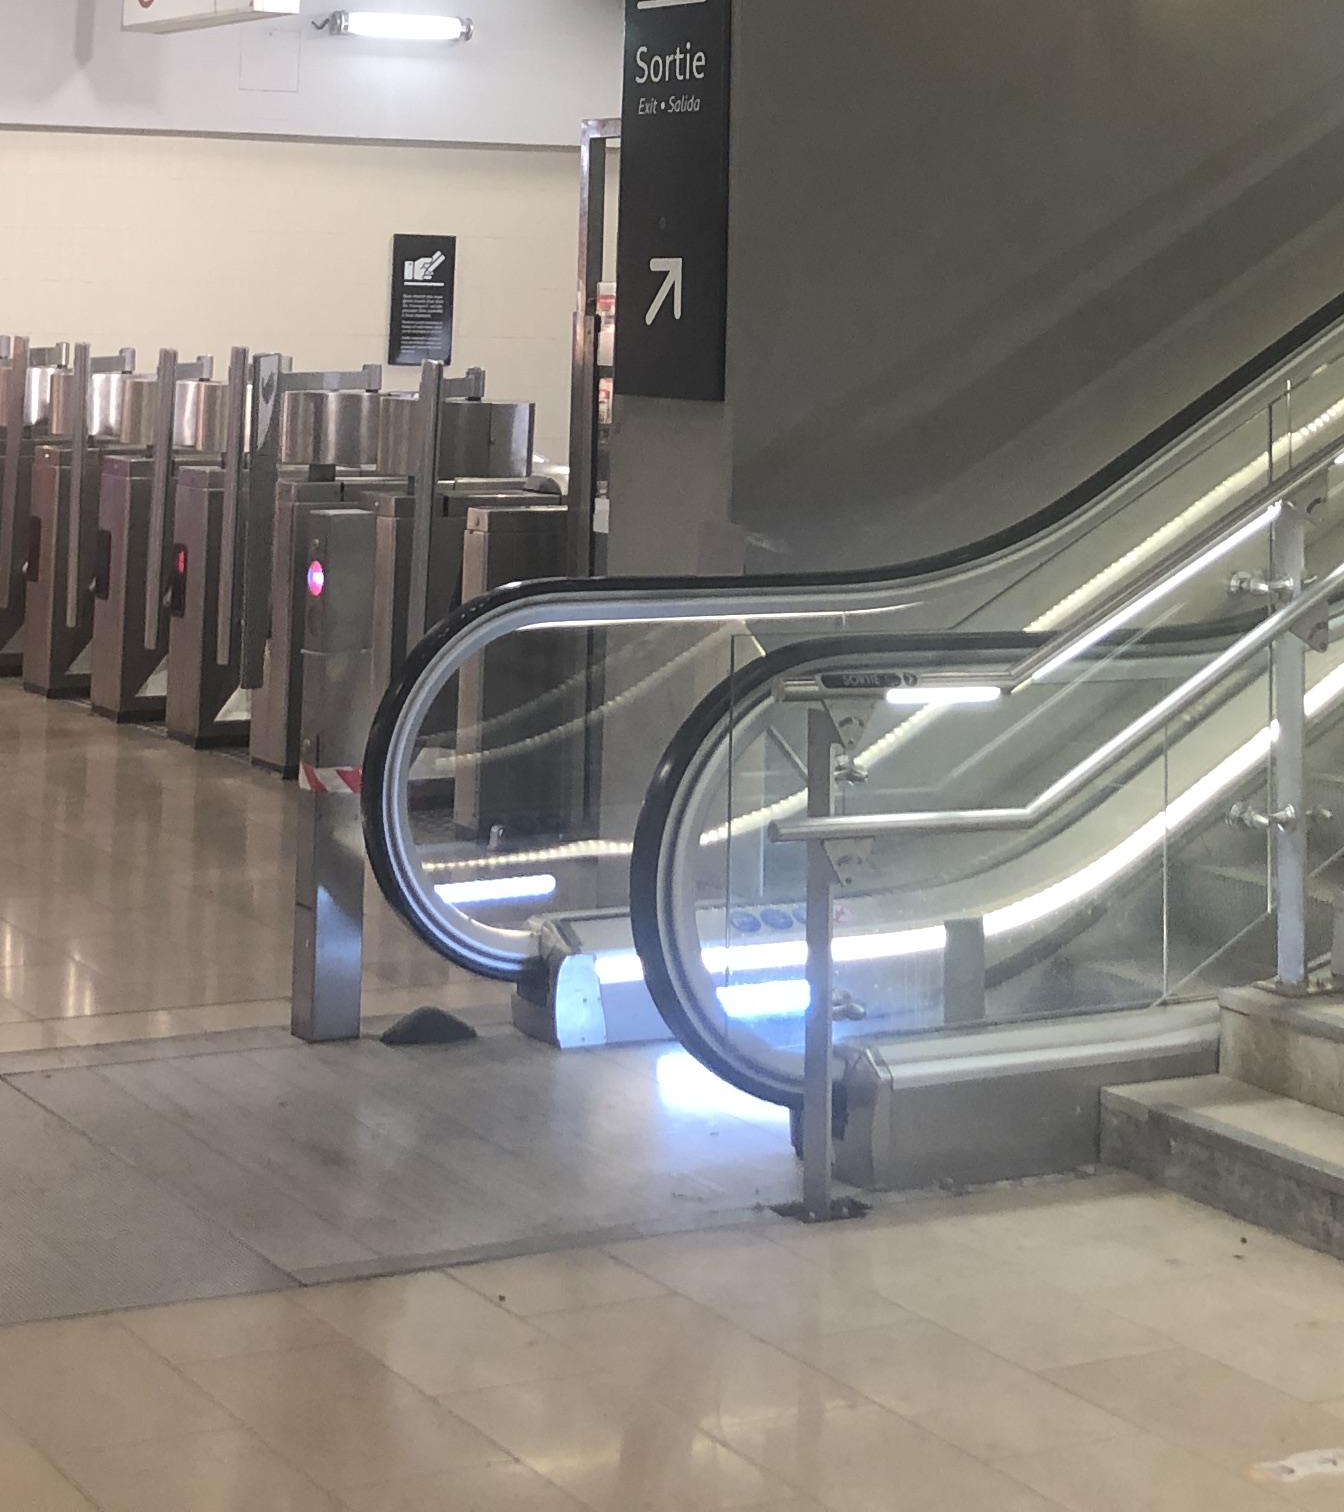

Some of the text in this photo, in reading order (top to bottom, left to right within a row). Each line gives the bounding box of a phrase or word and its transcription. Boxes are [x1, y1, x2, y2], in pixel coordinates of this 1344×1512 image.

[635, 41, 706, 84] Sortie
[638, 94, 701, 115] Exit Salida
[842, 674, 880, 686] SORTIE
